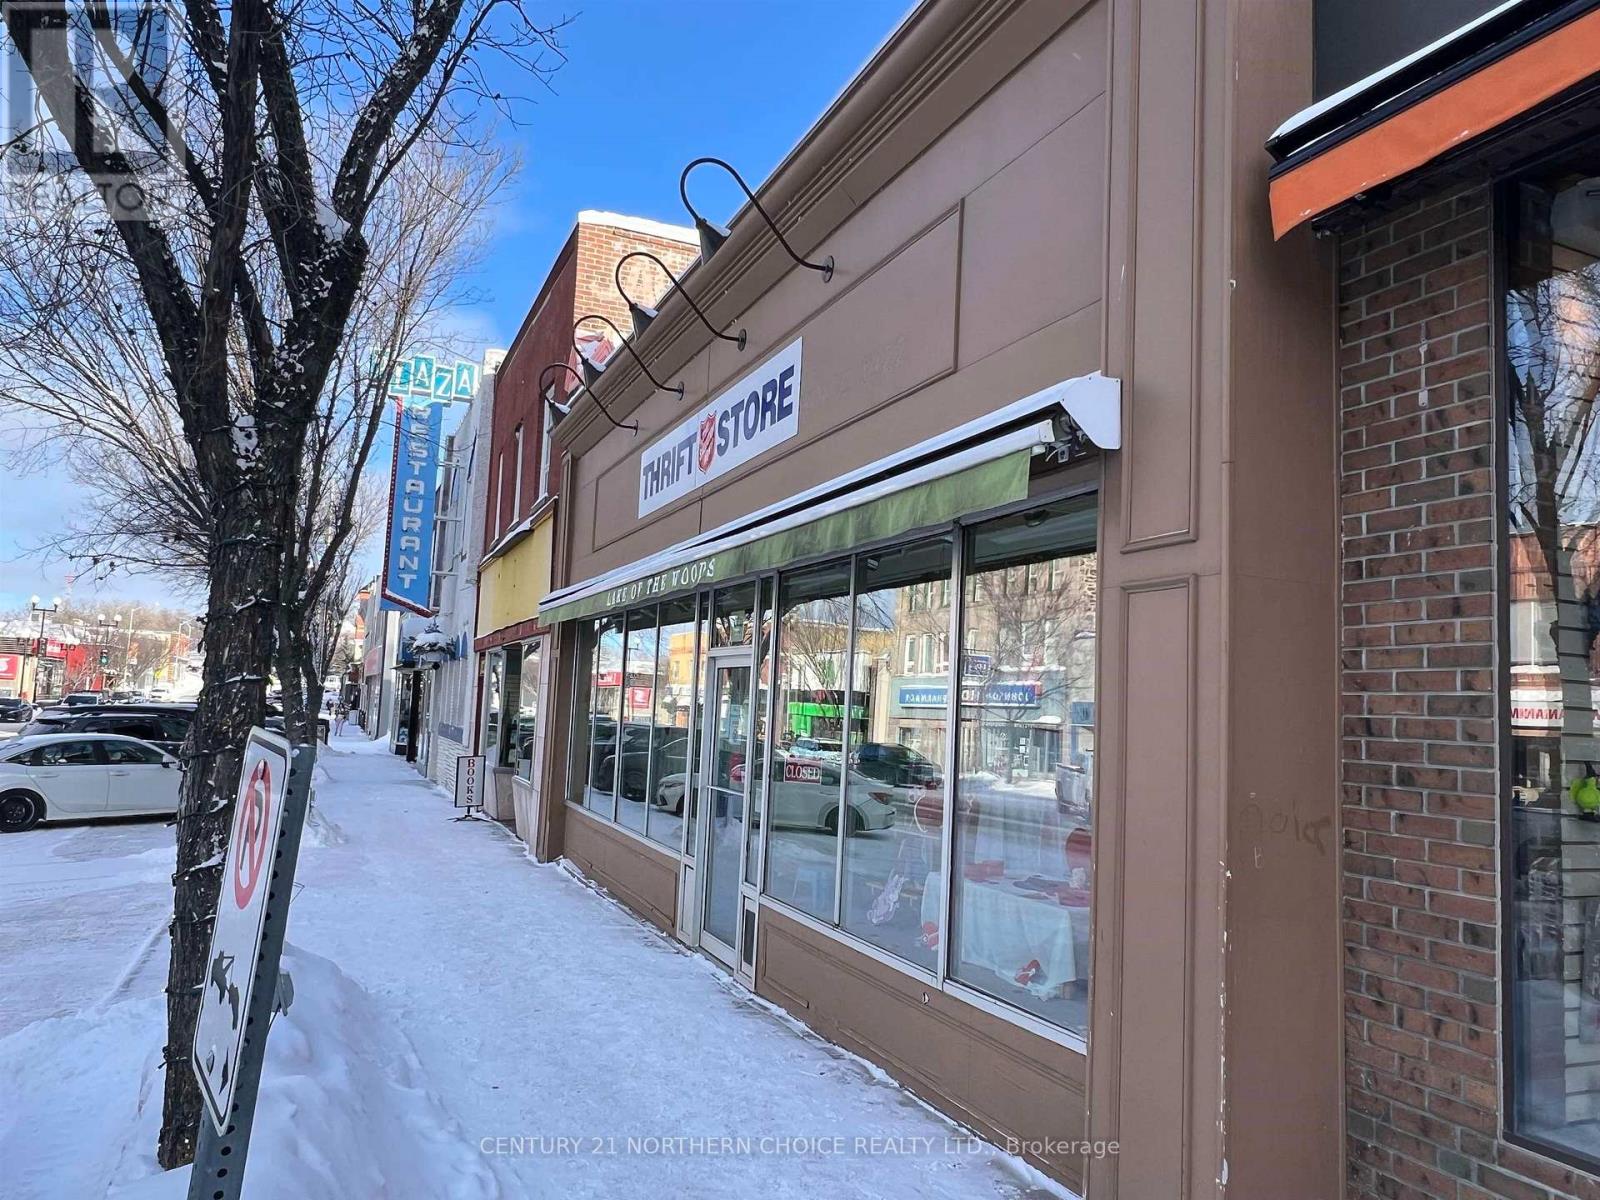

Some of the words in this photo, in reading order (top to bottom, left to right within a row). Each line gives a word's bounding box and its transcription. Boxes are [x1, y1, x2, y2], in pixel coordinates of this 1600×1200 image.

[642, 431, 699, 500] THRIFT
[716, 364, 795, 457] STORE
[398, 404, 431, 589] RESTAURANT
[606, 586, 628, 606] LAKE
[630, 582, 642, 600] OF
[646, 574, 667, 595] THE
[466, 758, 476, 804] BOOKS
[785, 764, 820, 780] CLOSED
